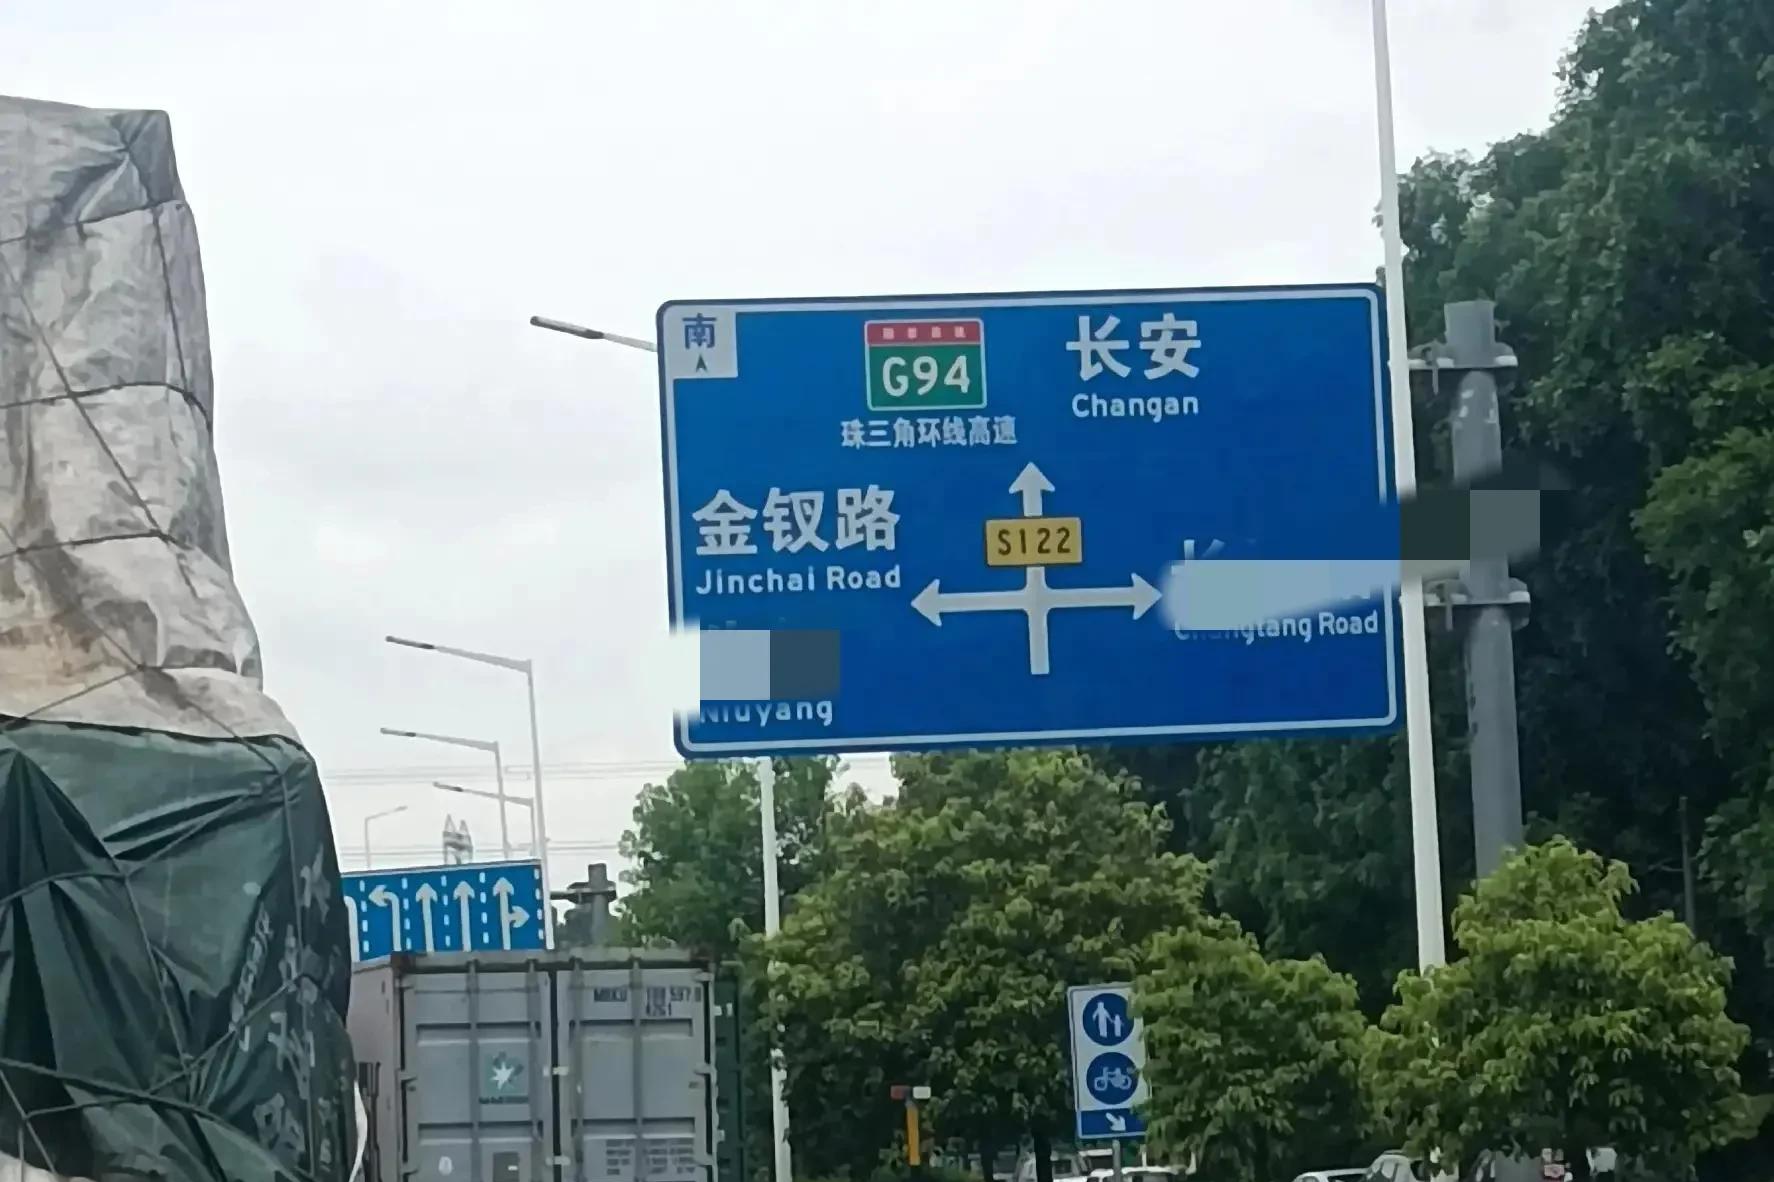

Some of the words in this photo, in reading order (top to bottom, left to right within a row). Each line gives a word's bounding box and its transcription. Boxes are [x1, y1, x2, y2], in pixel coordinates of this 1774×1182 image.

[681, 312, 718, 350] 南
[1065, 312, 1202, 382] 长安
[881, 355, 971, 398] G94
[1071, 393, 1200, 424] Changan
[840, 414, 1018, 450] 珠三角环线高速
[691, 484, 901, 556] 金钗路
[997, 526, 1072, 556] S122
[695, 565, 816, 596] Jinchai
[825, 564, 902, 591] Road
[1318, 608, 1379, 636] Road
